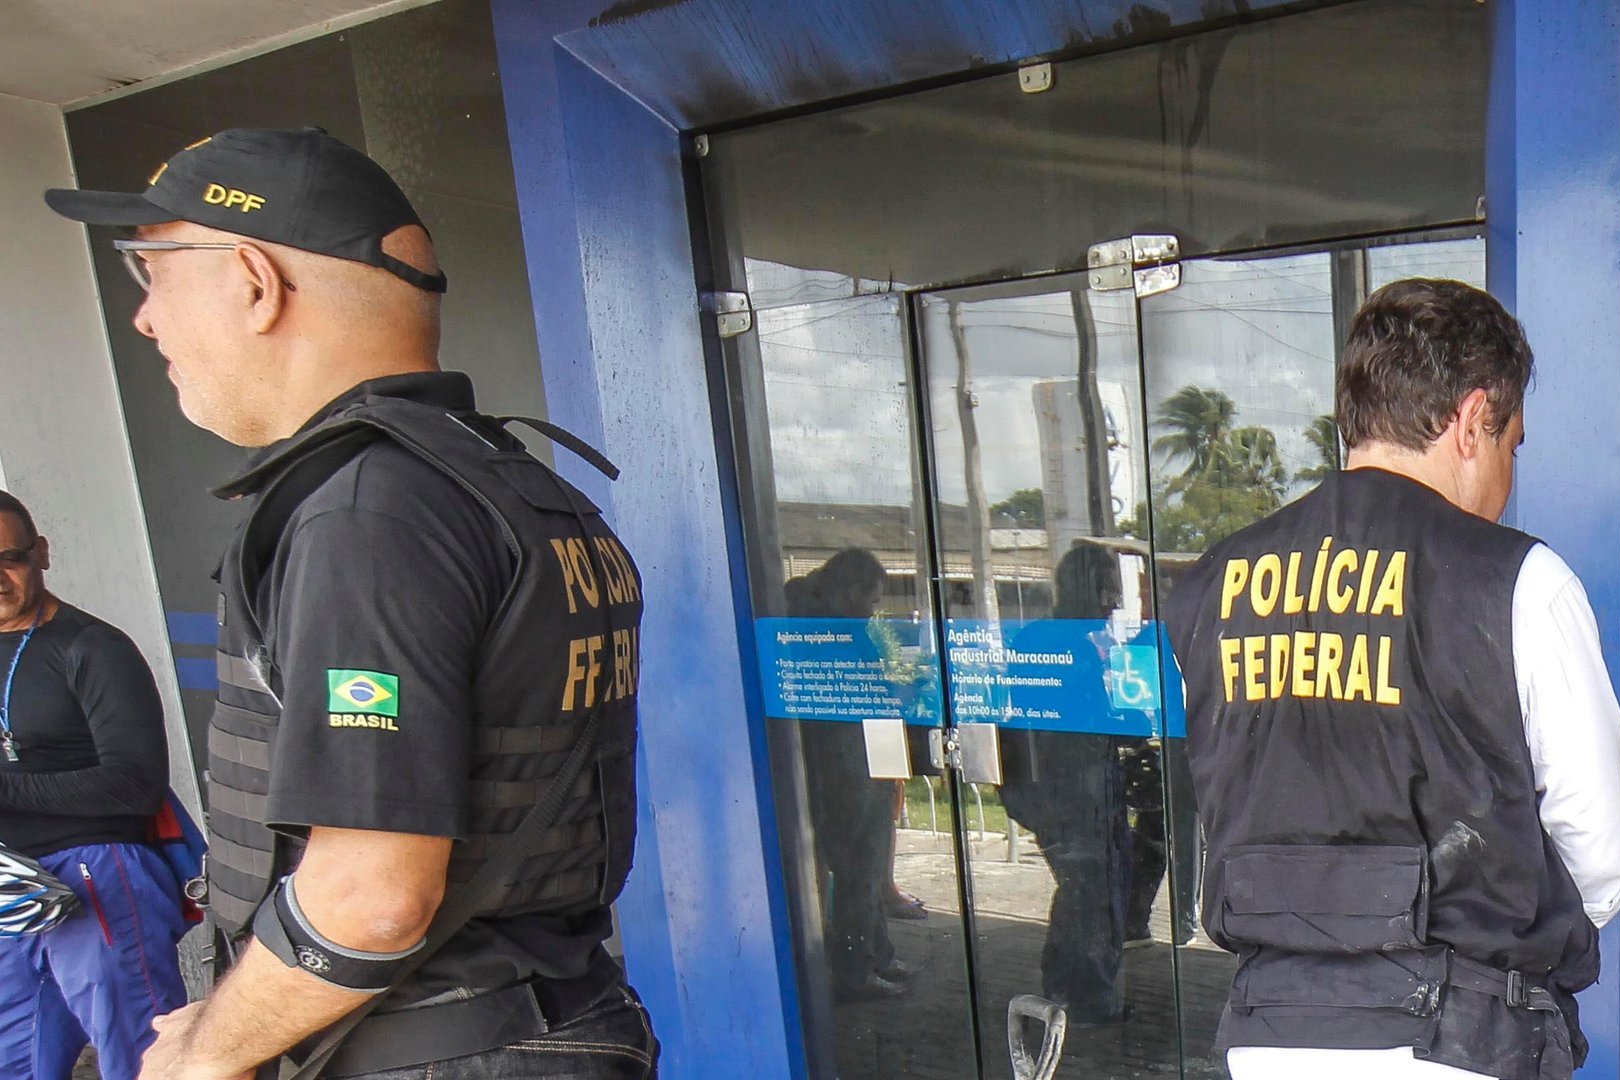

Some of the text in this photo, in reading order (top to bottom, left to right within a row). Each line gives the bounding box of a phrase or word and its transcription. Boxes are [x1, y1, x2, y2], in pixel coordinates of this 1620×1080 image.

[204, 183, 266, 213] DPF
[1220, 536, 1407, 620] POLÍCIA
[1006, 649, 1073, 665] Maracanaú
[1220, 631, 1401, 705] FEDERAL
[329, 713, 399, 732] BRASIL
